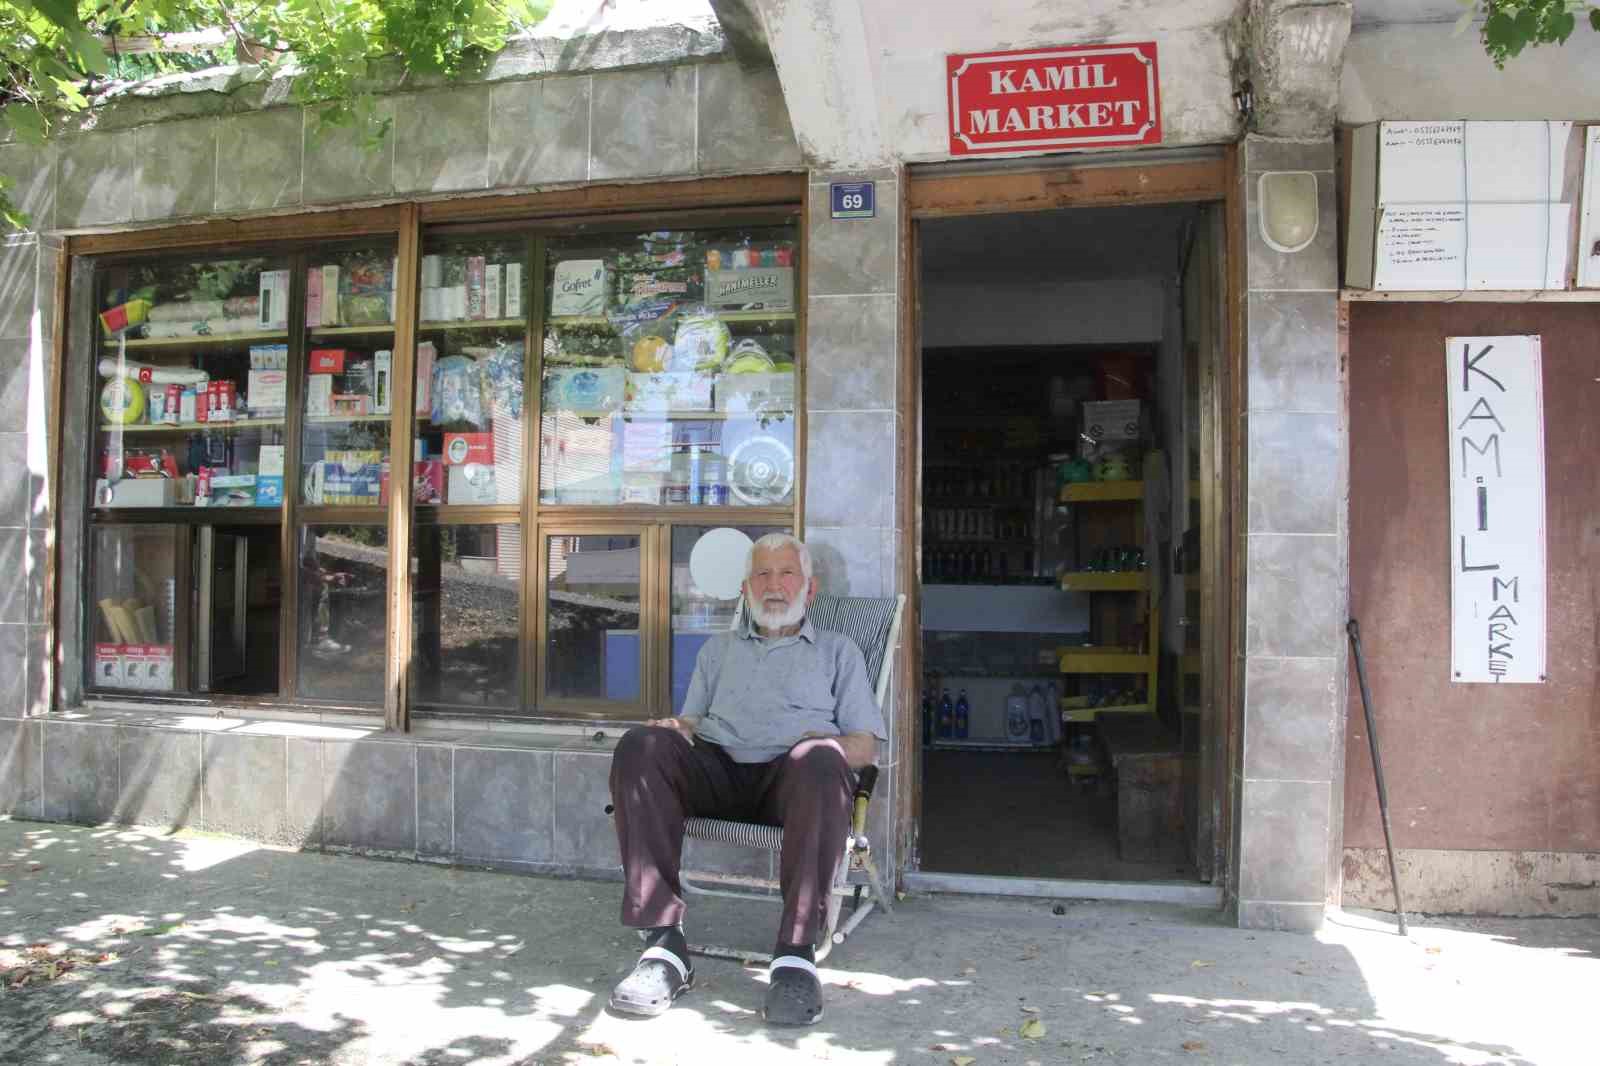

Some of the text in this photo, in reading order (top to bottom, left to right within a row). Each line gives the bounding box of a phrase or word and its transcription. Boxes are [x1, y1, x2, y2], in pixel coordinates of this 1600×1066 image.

[988, 58, 1117, 95] KAMİL
[969, 100, 1141, 135] MARKET
[842, 194, 863, 209] 69
[1488, 576, 1519, 684] MARKET
